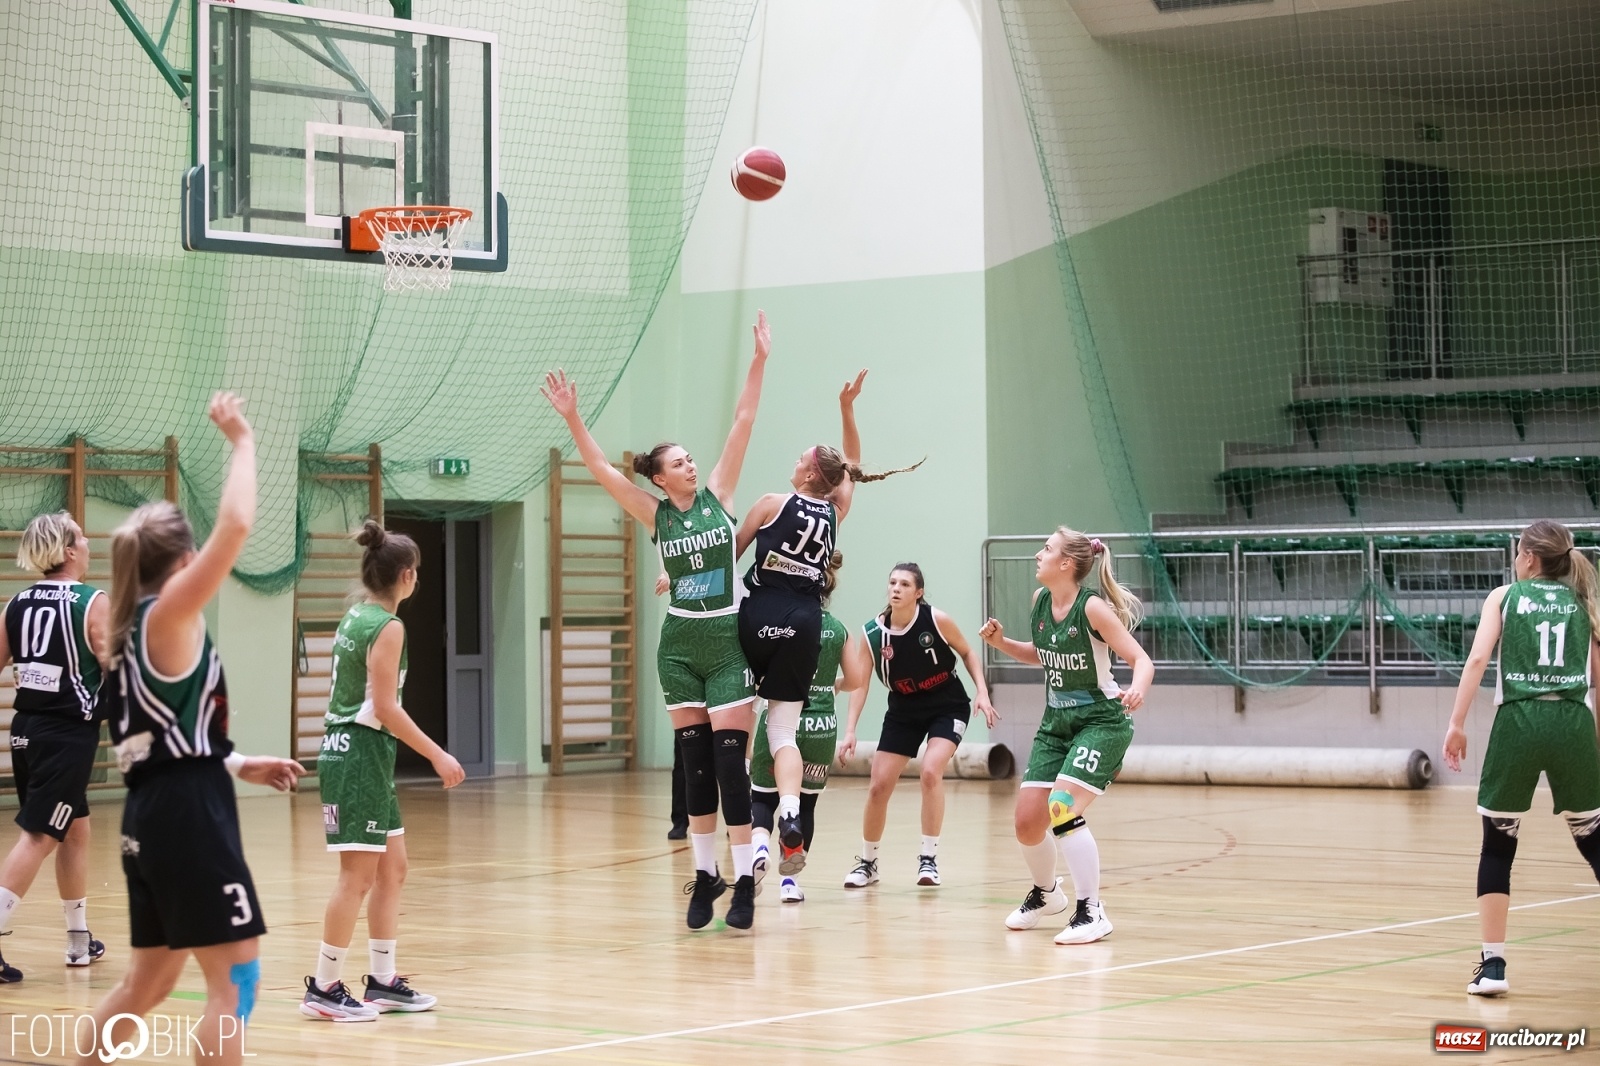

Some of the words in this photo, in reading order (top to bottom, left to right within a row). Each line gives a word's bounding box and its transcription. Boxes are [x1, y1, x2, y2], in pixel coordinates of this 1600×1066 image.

[662, 526, 729, 558] KATOWICE
[781, 511, 830, 563] 35
[688, 553, 704, 570] 18
[21, 606, 57, 658] 10
[1535, 621, 1565, 667] 11
[924, 647, 938, 665] 7
[1037, 648, 1088, 671] ATOWICE
[1049, 670, 1063, 688] 25
[1505, 672, 1526, 681] AZS
[1072, 746, 1101, 773] 25
[49, 801, 73, 831] 10
[223, 883, 253, 926] 3
